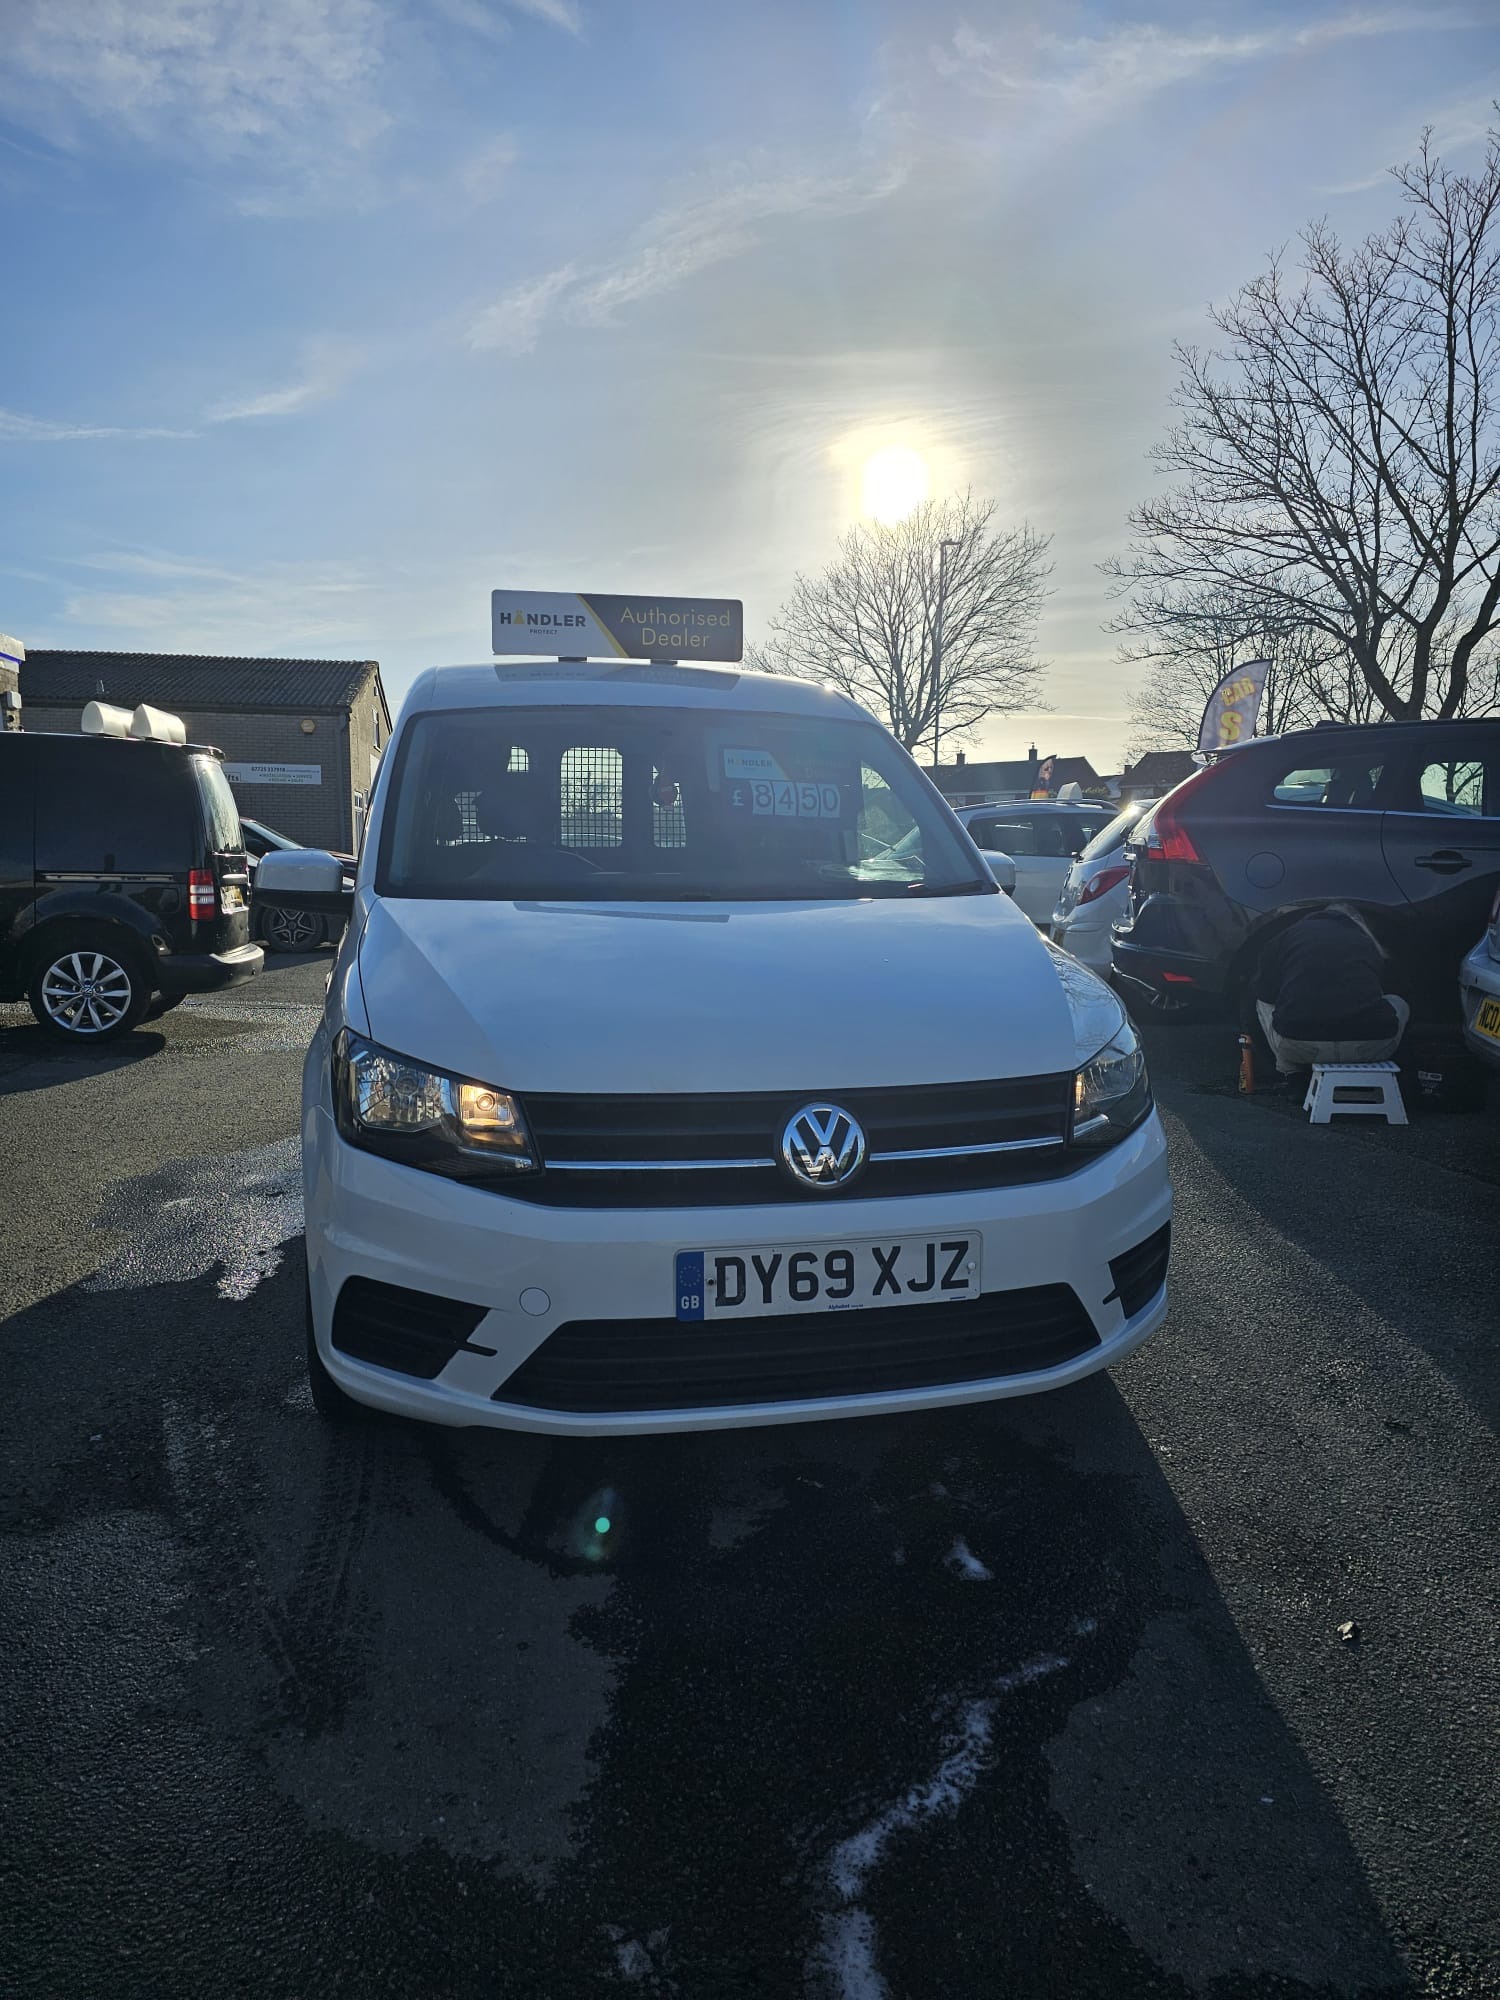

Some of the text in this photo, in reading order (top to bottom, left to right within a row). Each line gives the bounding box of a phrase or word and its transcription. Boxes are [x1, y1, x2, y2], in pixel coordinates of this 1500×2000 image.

[620, 607, 730, 626] Authorised
[642, 629, 710, 647] Dealer
[1221, 677, 1255, 706] CAR
[1219, 711, 1243, 747] S
[715, 1240, 970, 1308] DY69 XJZ
[680, 1295, 700, 1309] GB
